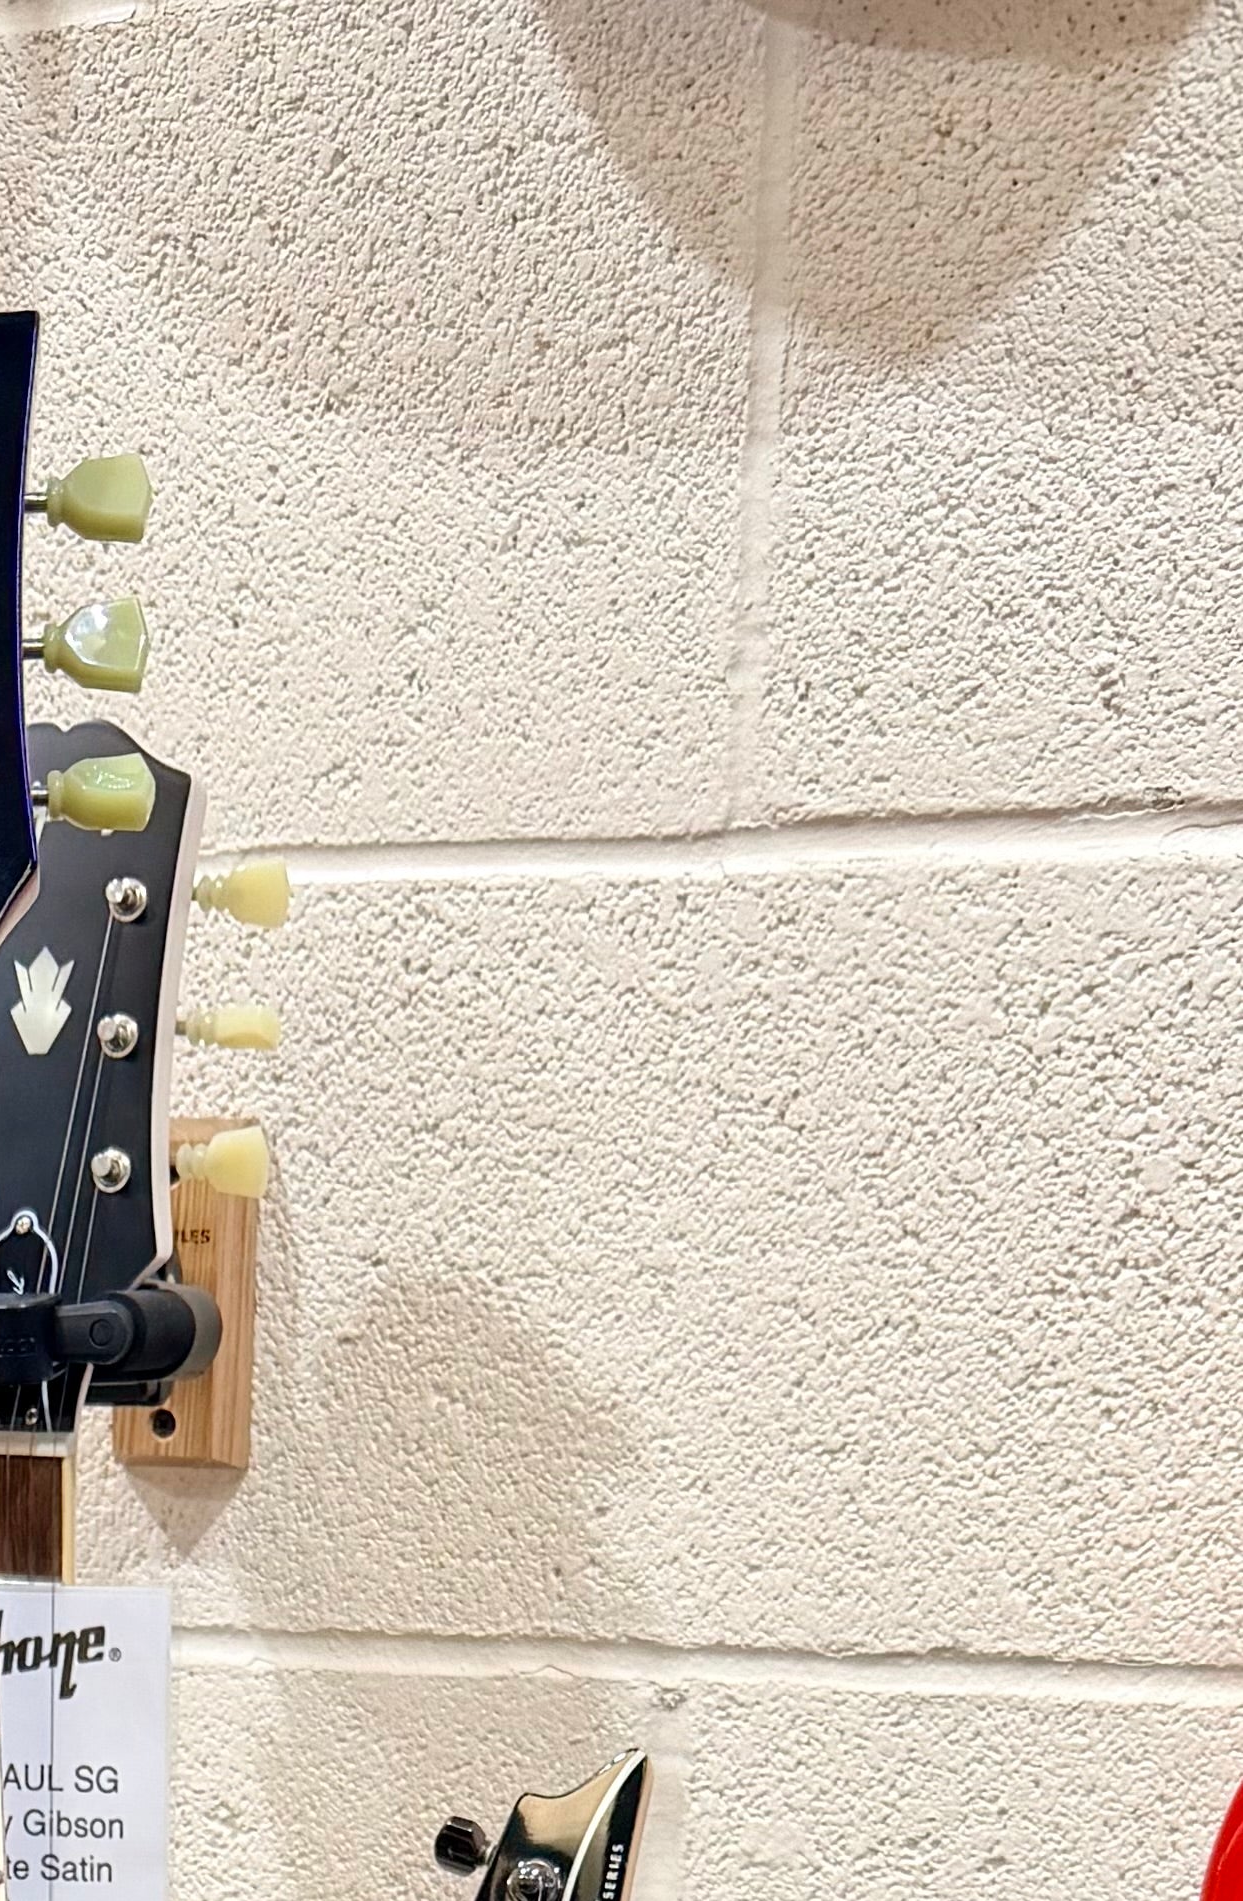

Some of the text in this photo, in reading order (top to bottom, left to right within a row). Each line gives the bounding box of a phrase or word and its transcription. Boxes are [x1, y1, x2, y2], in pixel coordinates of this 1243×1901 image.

[74, 1765, 119, 1794] SG
[23, 1809, 124, 1840] Gibson
[41, 1853, 113, 1882] Satin
[602, 1844, 625, 1900] SERIES
